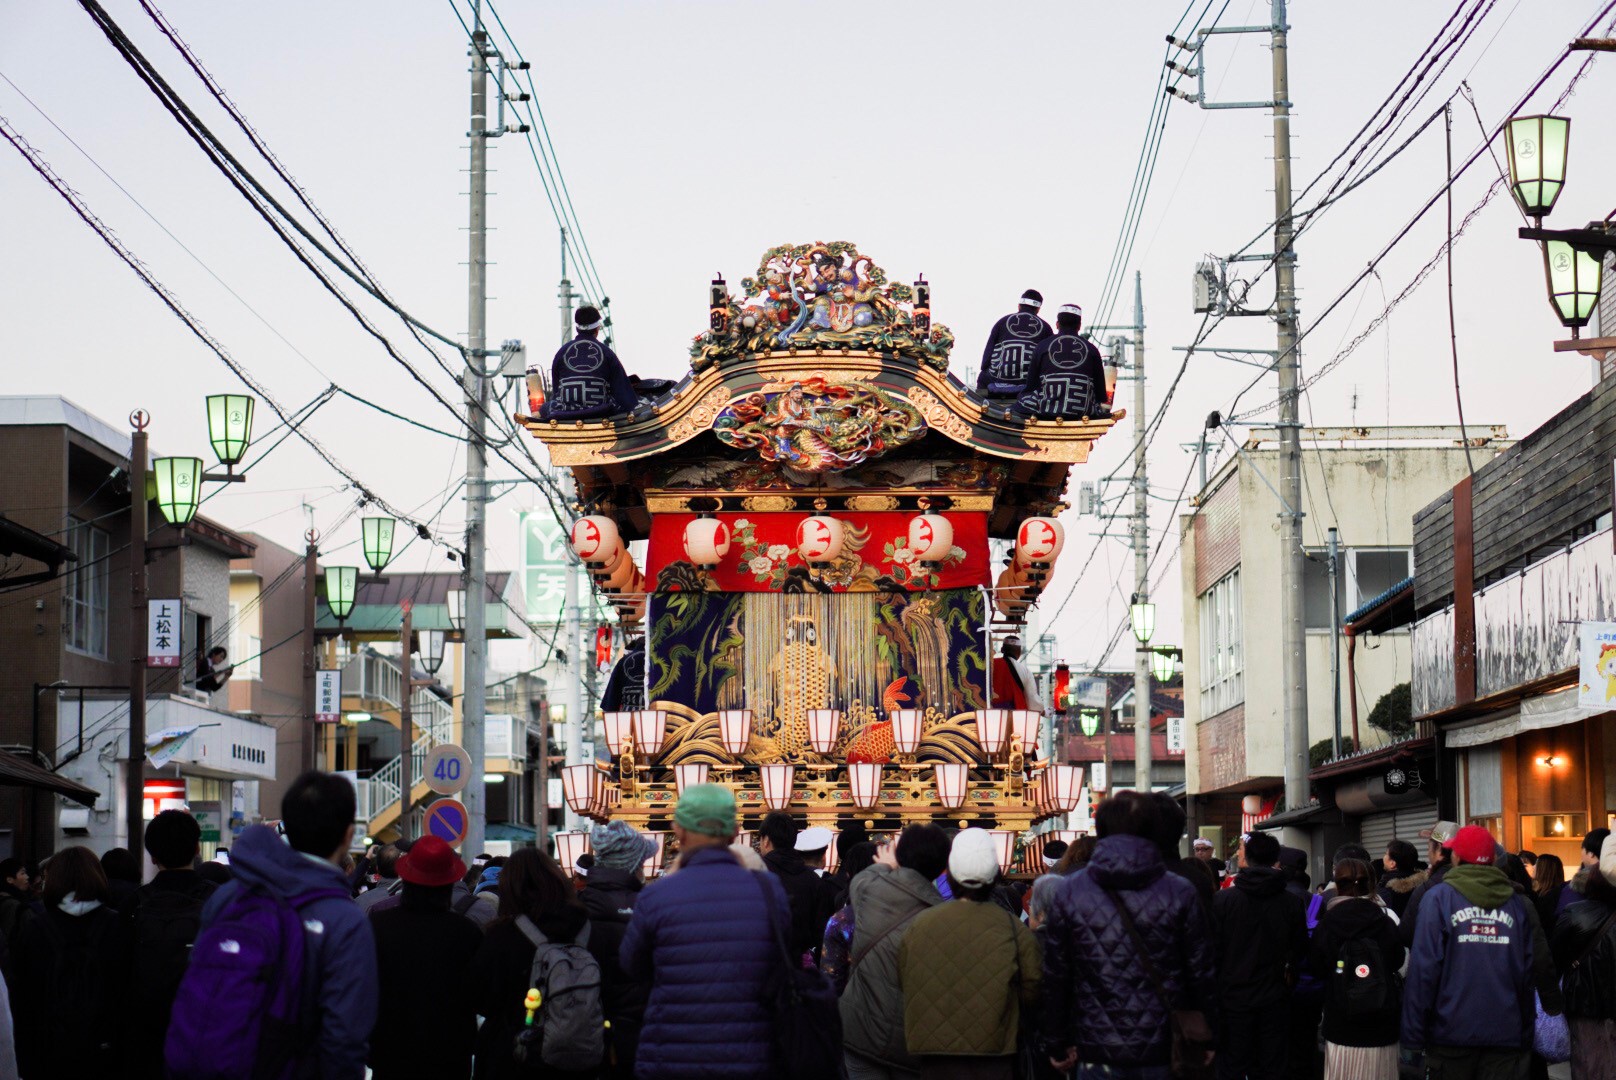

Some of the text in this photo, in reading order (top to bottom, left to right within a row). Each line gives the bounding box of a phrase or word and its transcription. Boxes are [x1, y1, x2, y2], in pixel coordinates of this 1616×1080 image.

[710, 287, 727, 332] 上町
[913, 287, 930, 332] 上町
[156, 604, 171, 650] 上松本
[152, 656, 173, 665] 上町
[322, 673, 332, 712] 上町郵便局
[433, 758, 460, 780] 40
[1451, 906, 1514, 928] PORTLAND
[1488, 935, 1509, 944] CLUB
